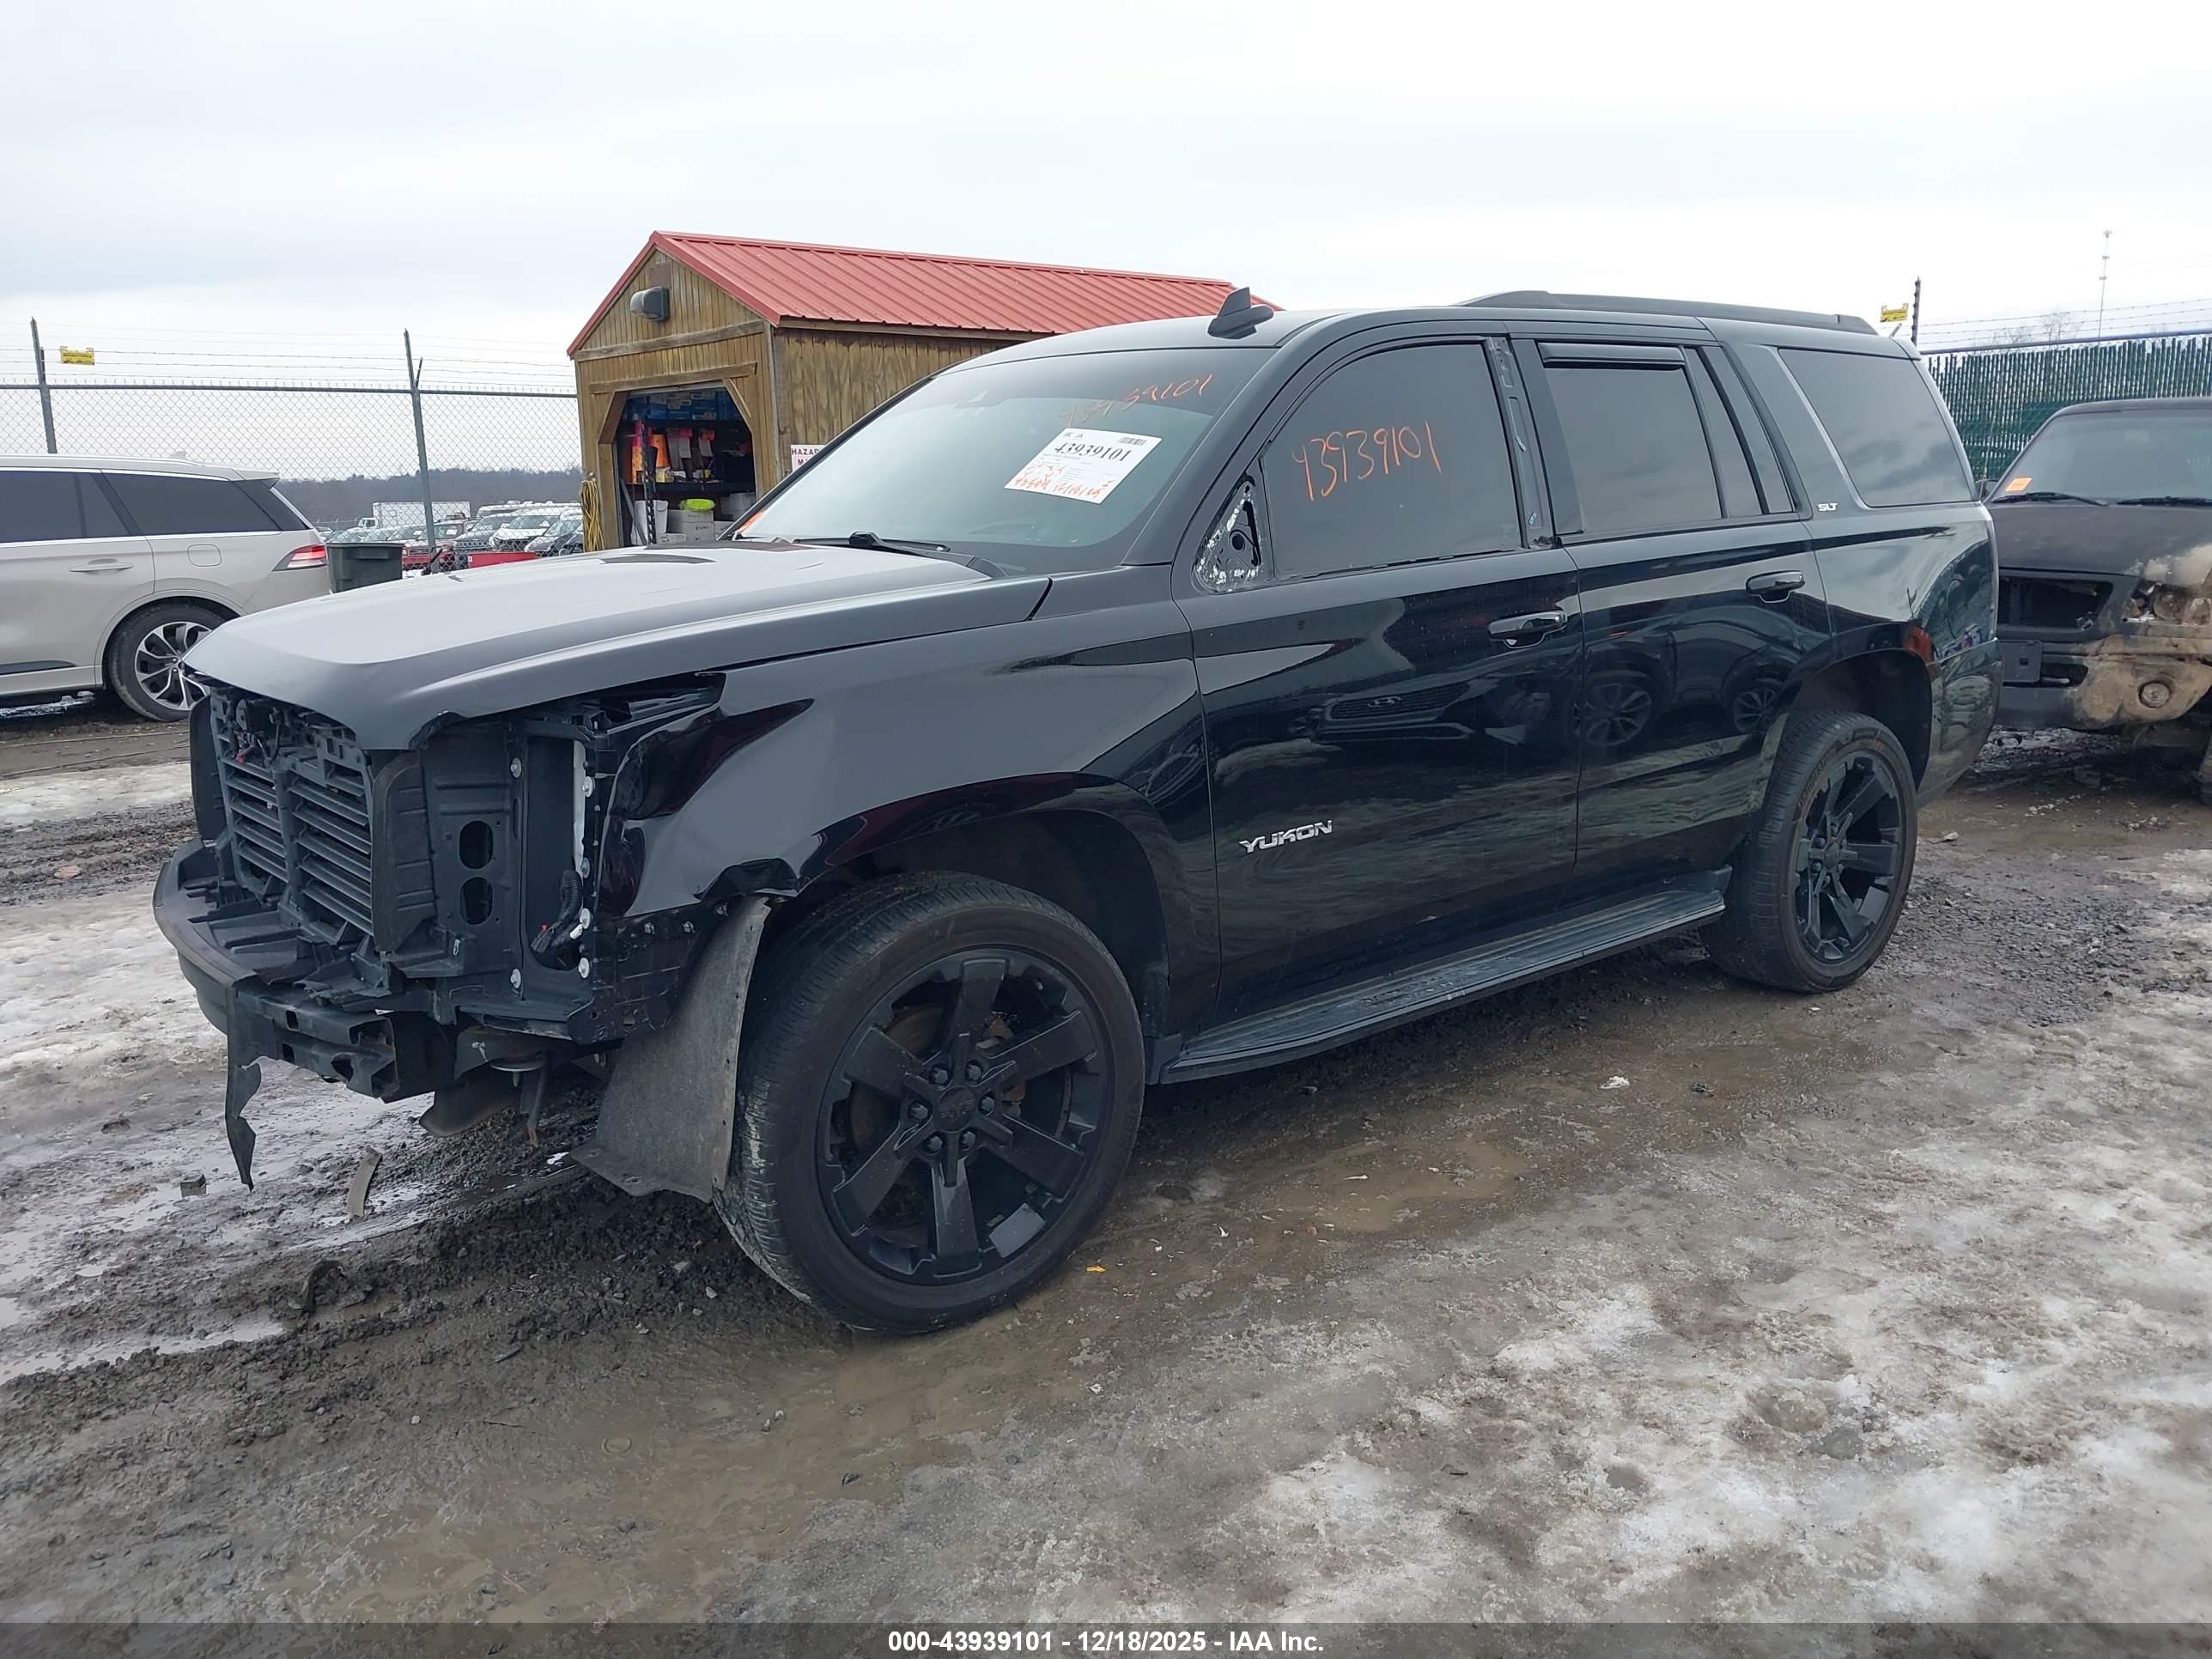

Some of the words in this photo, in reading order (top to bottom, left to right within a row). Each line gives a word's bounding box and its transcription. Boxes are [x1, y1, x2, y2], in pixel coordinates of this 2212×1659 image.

[1054, 441, 1133, 462] 43939101
[1291, 418, 1443, 501] 43939101
[1818, 502, 1838, 512] SLT
[1237, 819, 1333, 854] YUKON
